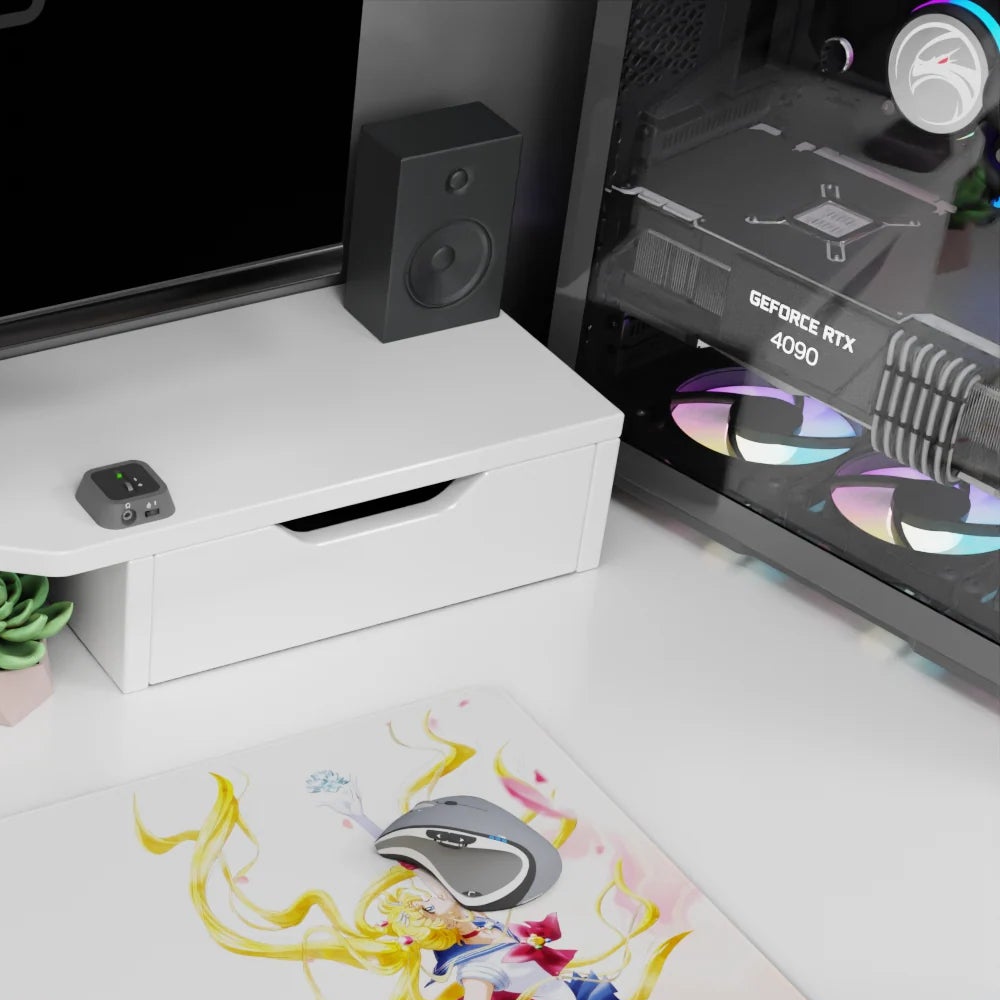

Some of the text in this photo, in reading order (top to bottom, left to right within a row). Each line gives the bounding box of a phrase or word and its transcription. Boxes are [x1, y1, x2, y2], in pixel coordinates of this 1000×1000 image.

[749, 289, 857, 354] GEFORCE RTX
[770, 331, 819, 367] 4090
